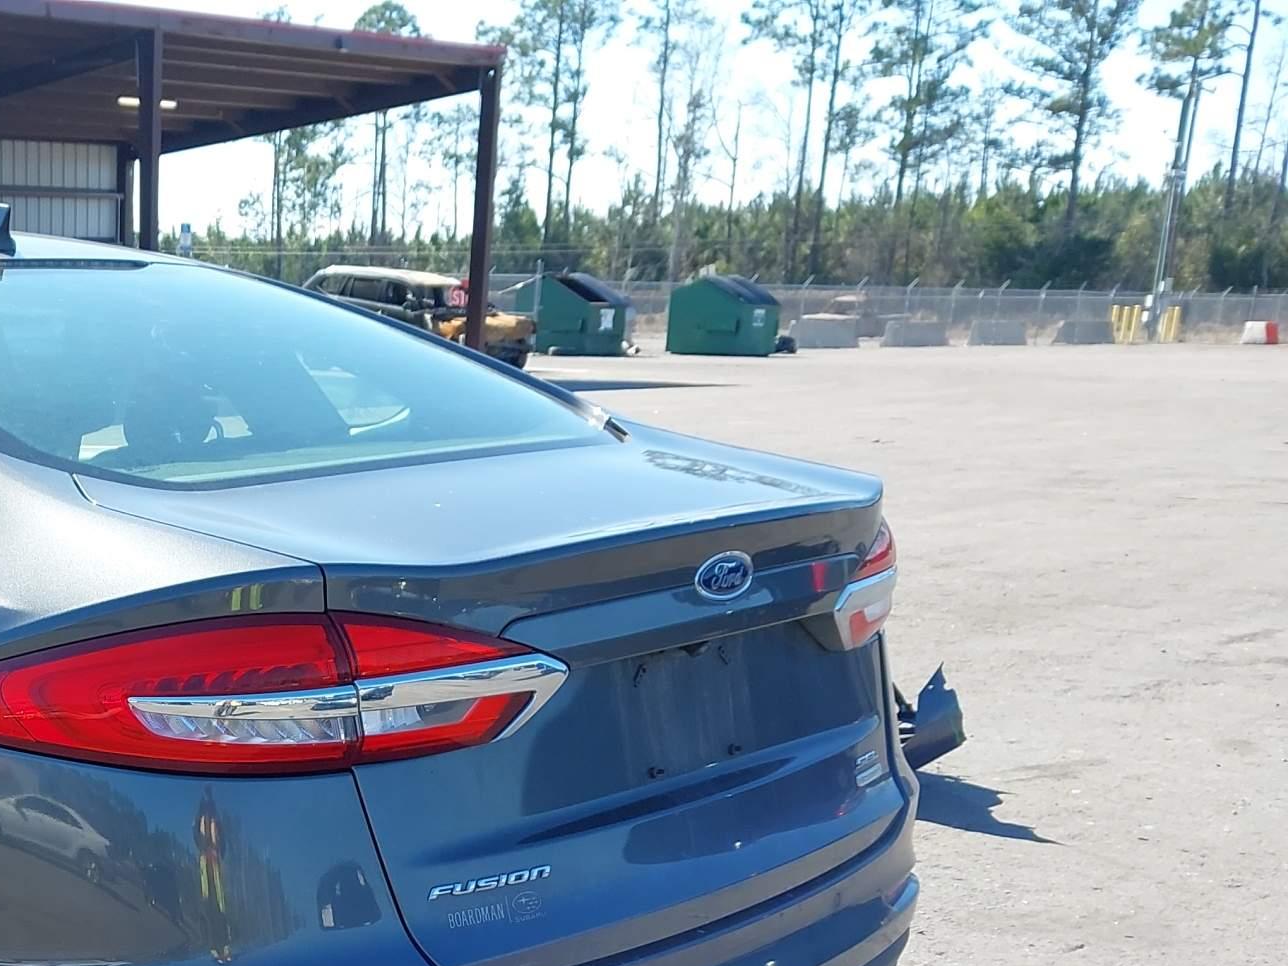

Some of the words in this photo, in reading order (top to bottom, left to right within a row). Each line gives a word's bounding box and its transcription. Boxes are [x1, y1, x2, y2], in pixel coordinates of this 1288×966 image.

[711, 562, 745, 590] Ford
[428, 865, 551, 901] FUSION
[447, 903, 505, 928] BOARDMAN
